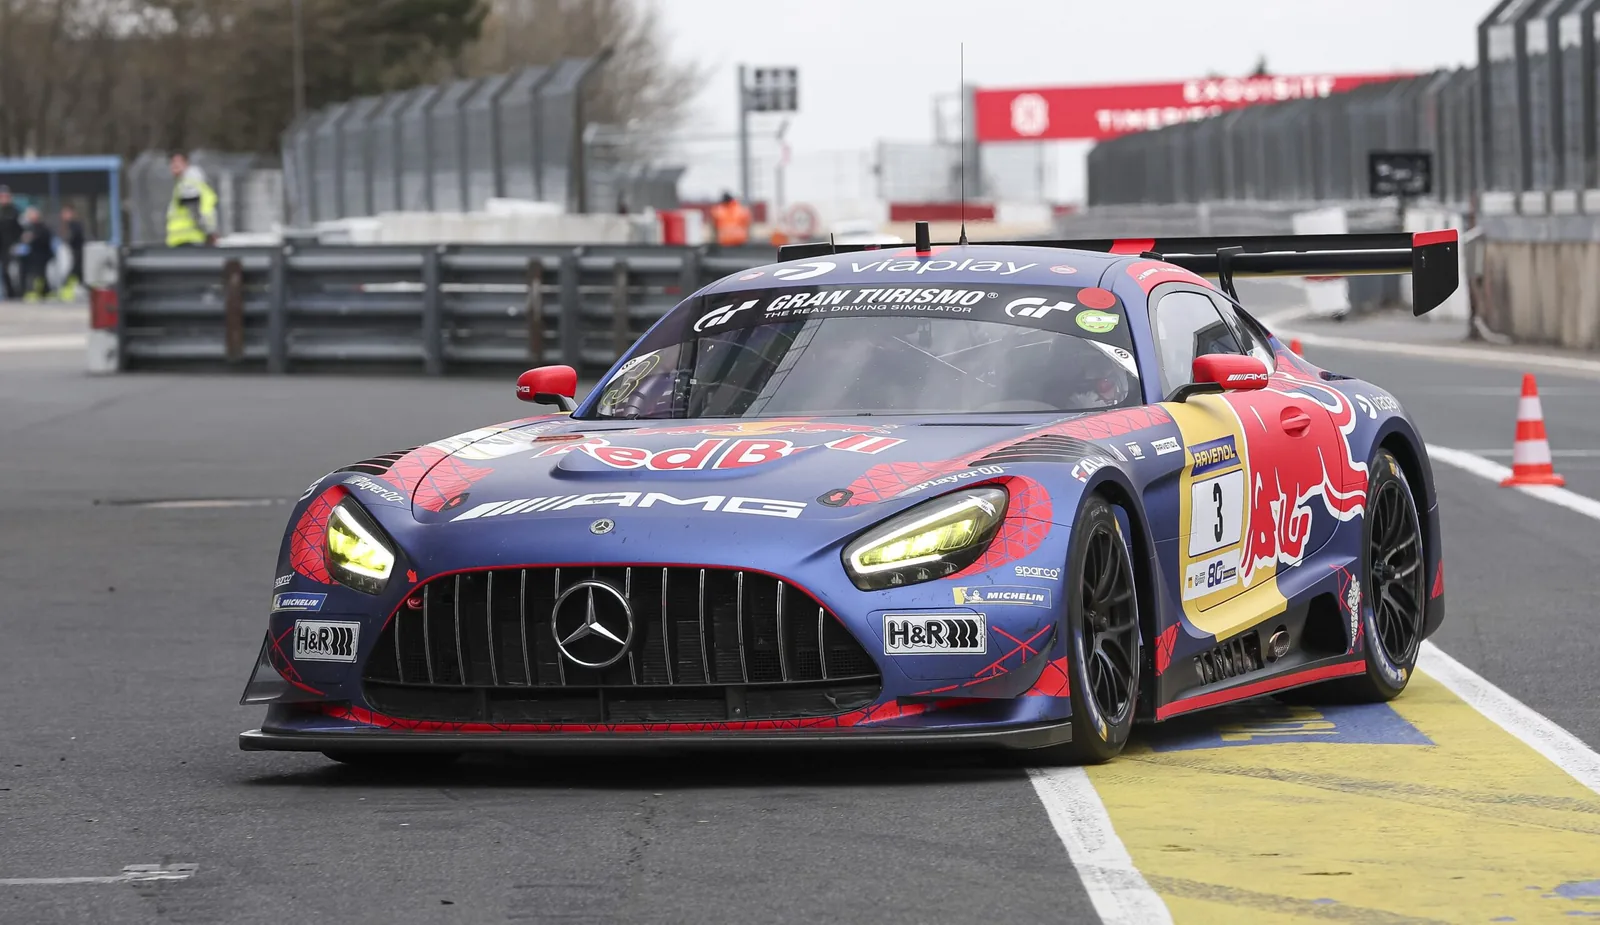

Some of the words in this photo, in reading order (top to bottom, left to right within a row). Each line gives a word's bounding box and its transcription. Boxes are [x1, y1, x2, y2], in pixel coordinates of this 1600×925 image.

[851, 258, 1038, 275] viaplay
[764, 310, 790, 319] THE
[794, 307, 827, 316] REAL
[831, 304, 887, 312] DRIVING
[890, 304, 972, 313] SIMULATOR
[766, 290, 852, 311] GRAN
[852, 288, 987, 305] TURISMO
[711, 433, 907, 471] Bll
[1194, 444, 1236, 468] RAVENOL
[550, 492, 808, 519] AMG
[1211, 482, 1223, 543] 3
[281, 598, 320, 607] MICHELIN
[986, 591, 1045, 602] MICHELIN
[296, 626, 331, 654] H&R
[888, 619, 948, 649] H&R
